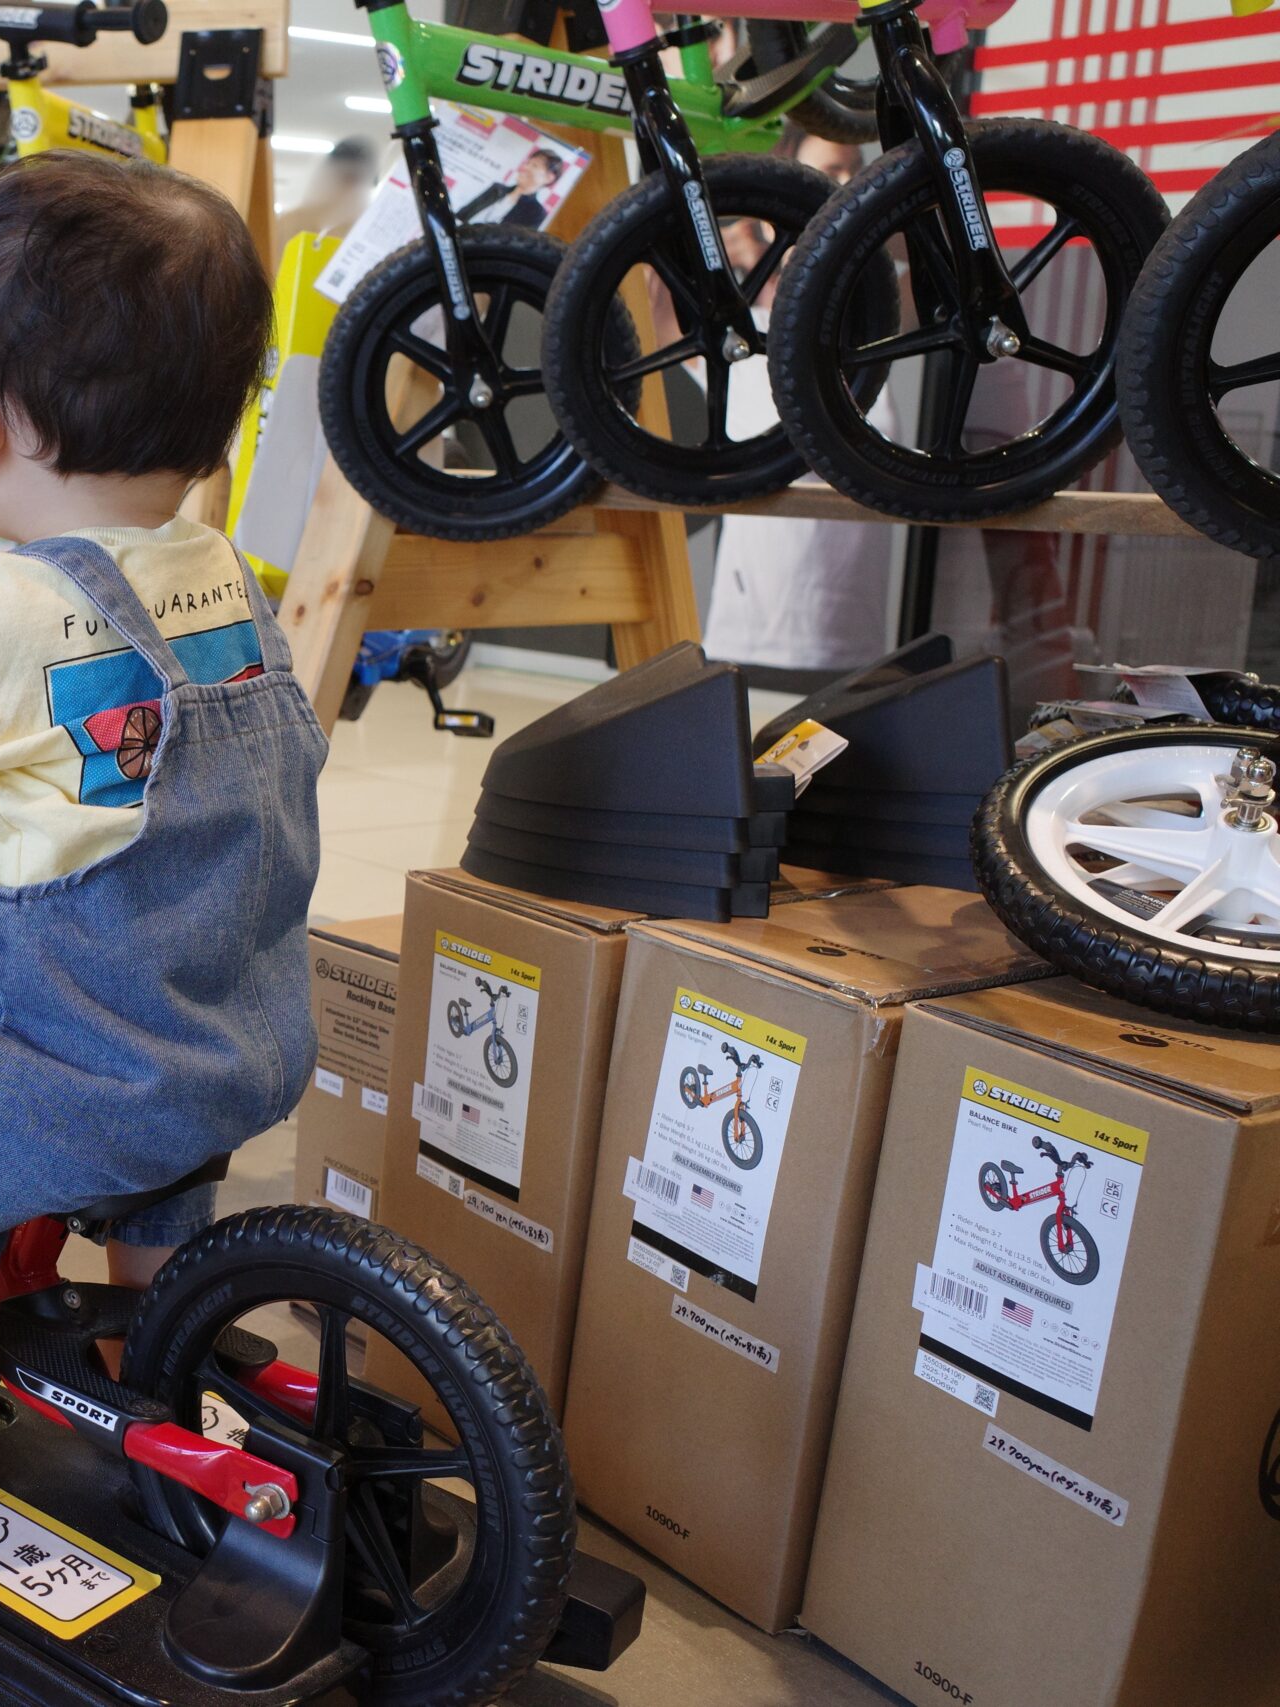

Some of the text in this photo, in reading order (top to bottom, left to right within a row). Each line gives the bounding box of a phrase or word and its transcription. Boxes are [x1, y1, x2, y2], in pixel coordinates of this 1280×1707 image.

[456, 42, 638, 117] STRIDE
[950, 167, 990, 252] STRIDER
[688, 197, 723, 272] STRIDER
[450, 942, 493, 966] STRIDER
[330, 963, 399, 1000] STRIDER
[346, 989, 377, 1011] Rocking
[692, 1000, 745, 1030] STRIDER
[674, 1021, 701, 1036] BALANCE
[701, 1031, 713, 1041] BIKE
[765, 1034, 797, 1053] 14x Sport
[1120, 1022, 1217, 1052] CONTENTS
[989, 1086, 1063, 1123] STRIDER
[968, 1109, 1018, 1134] BALANCE BIKE
[1093, 1130, 1139, 1153] 14x Sport
[689, 1160, 716, 1180] ASSEMBLY
[714, 1173, 742, 1193] REQUIRED
[957, 1213, 974, 1226] Rider
[967, 1240, 985, 1255] Rider
[984, 1247, 1008, 1267] Weight
[969, 1230, 992, 1249] Weight
[1013, 1250, 1033, 1267] (13.5
[975, 1261, 1072, 1312] ADULT ASSEMBLY REQUIRED
[920, 1370, 957, 1395] 2500690
[921, 1362, 960, 1388] 2025-12-26
[50, 1389, 114, 1426] SPORT
[350, 1294, 503, 1533] STRIDER ULTRALIGHT
[646, 1504, 691, 1540] 10900-F
[79, 1571, 112, 1591] まで
[913, 1660, 974, 1706] 10900-F
